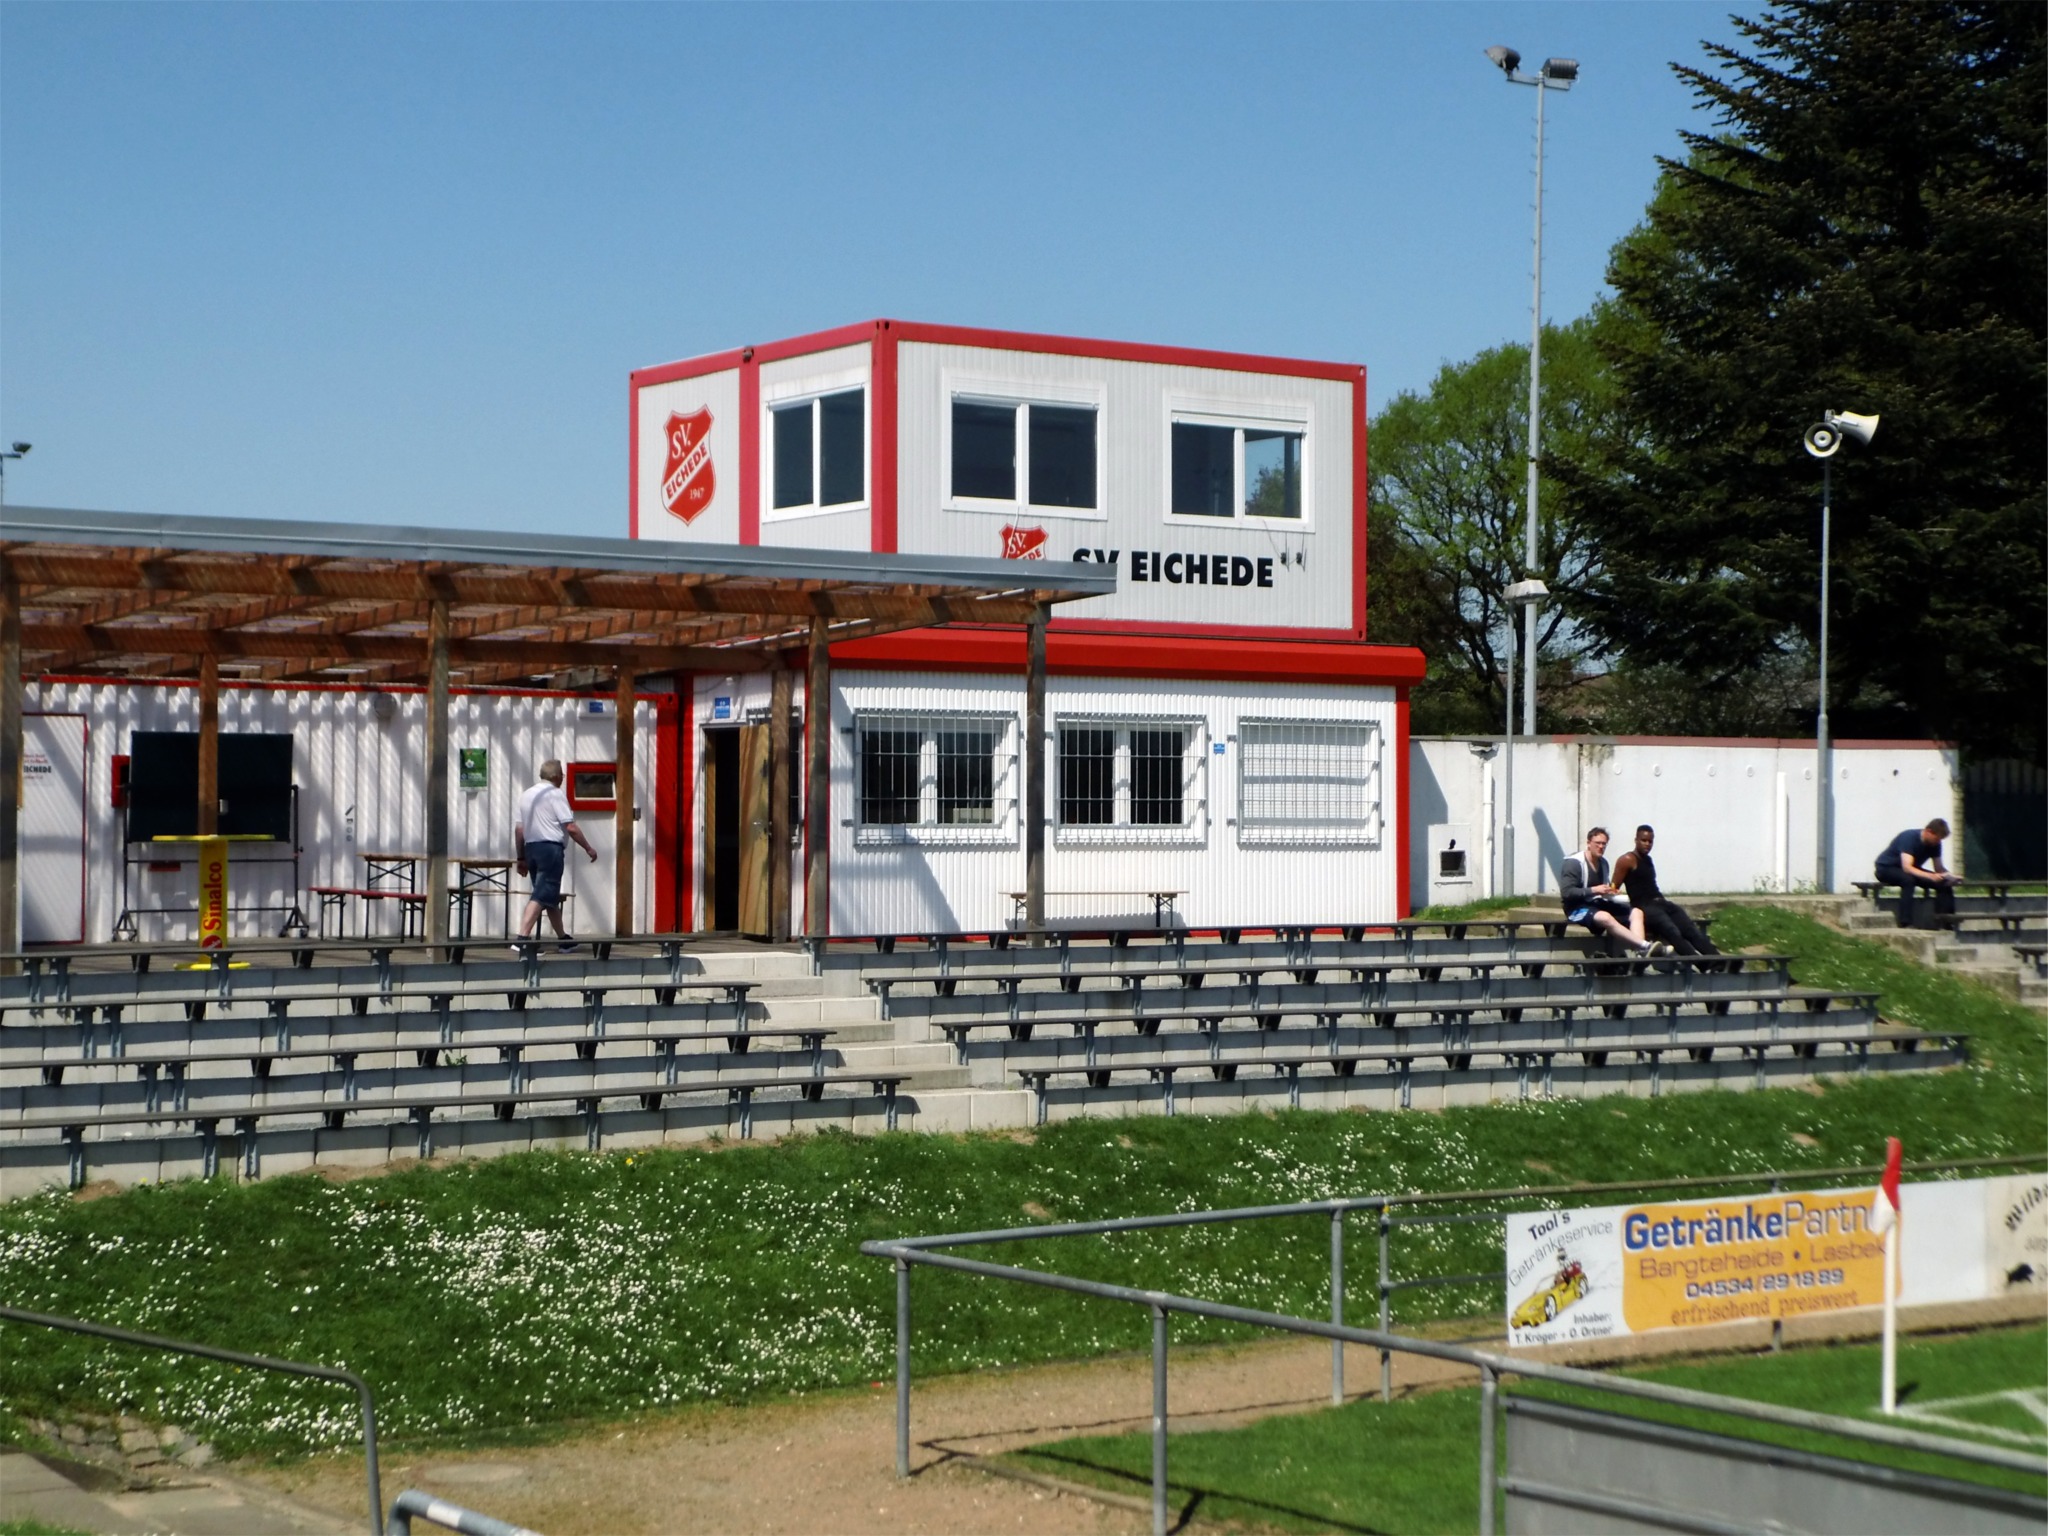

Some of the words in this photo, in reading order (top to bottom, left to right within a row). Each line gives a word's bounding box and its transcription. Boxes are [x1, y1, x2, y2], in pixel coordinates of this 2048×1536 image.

[665, 441, 708, 500] EICHEDE
[1131, 550, 1274, 588] EICHEDE
[203, 861, 223, 931] Sinalco
[1625, 1200, 1872, 1251] GetränkePartn
[1640, 1248, 1784, 1279] Bargteheide
[1671, 1297, 1770, 1326] erfrischend
[1779, 1290, 1858, 1317] preiswert
